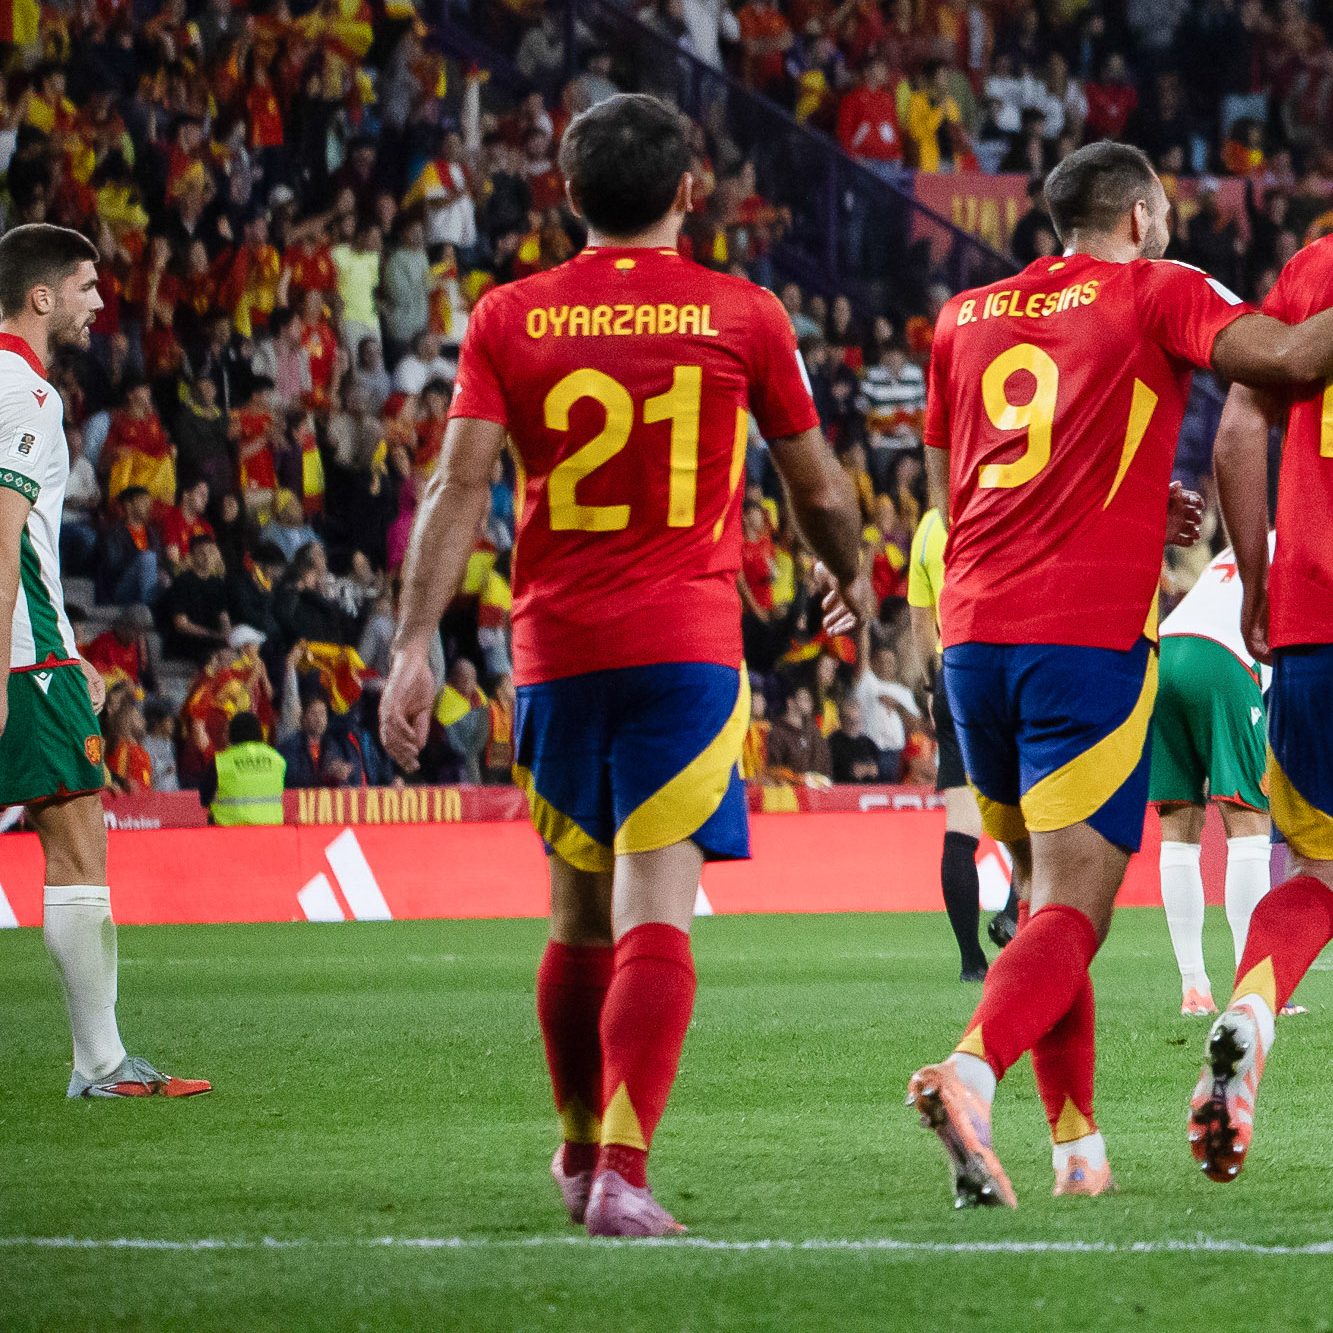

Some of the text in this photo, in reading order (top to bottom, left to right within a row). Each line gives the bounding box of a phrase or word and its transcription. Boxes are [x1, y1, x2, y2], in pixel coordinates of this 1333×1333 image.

[526, 303, 719, 339] OYARZABAL
[956, 279, 1100, 326] B. IGLESIAS
[544, 365, 703, 532] 21
[978, 342, 1060, 489] 9
